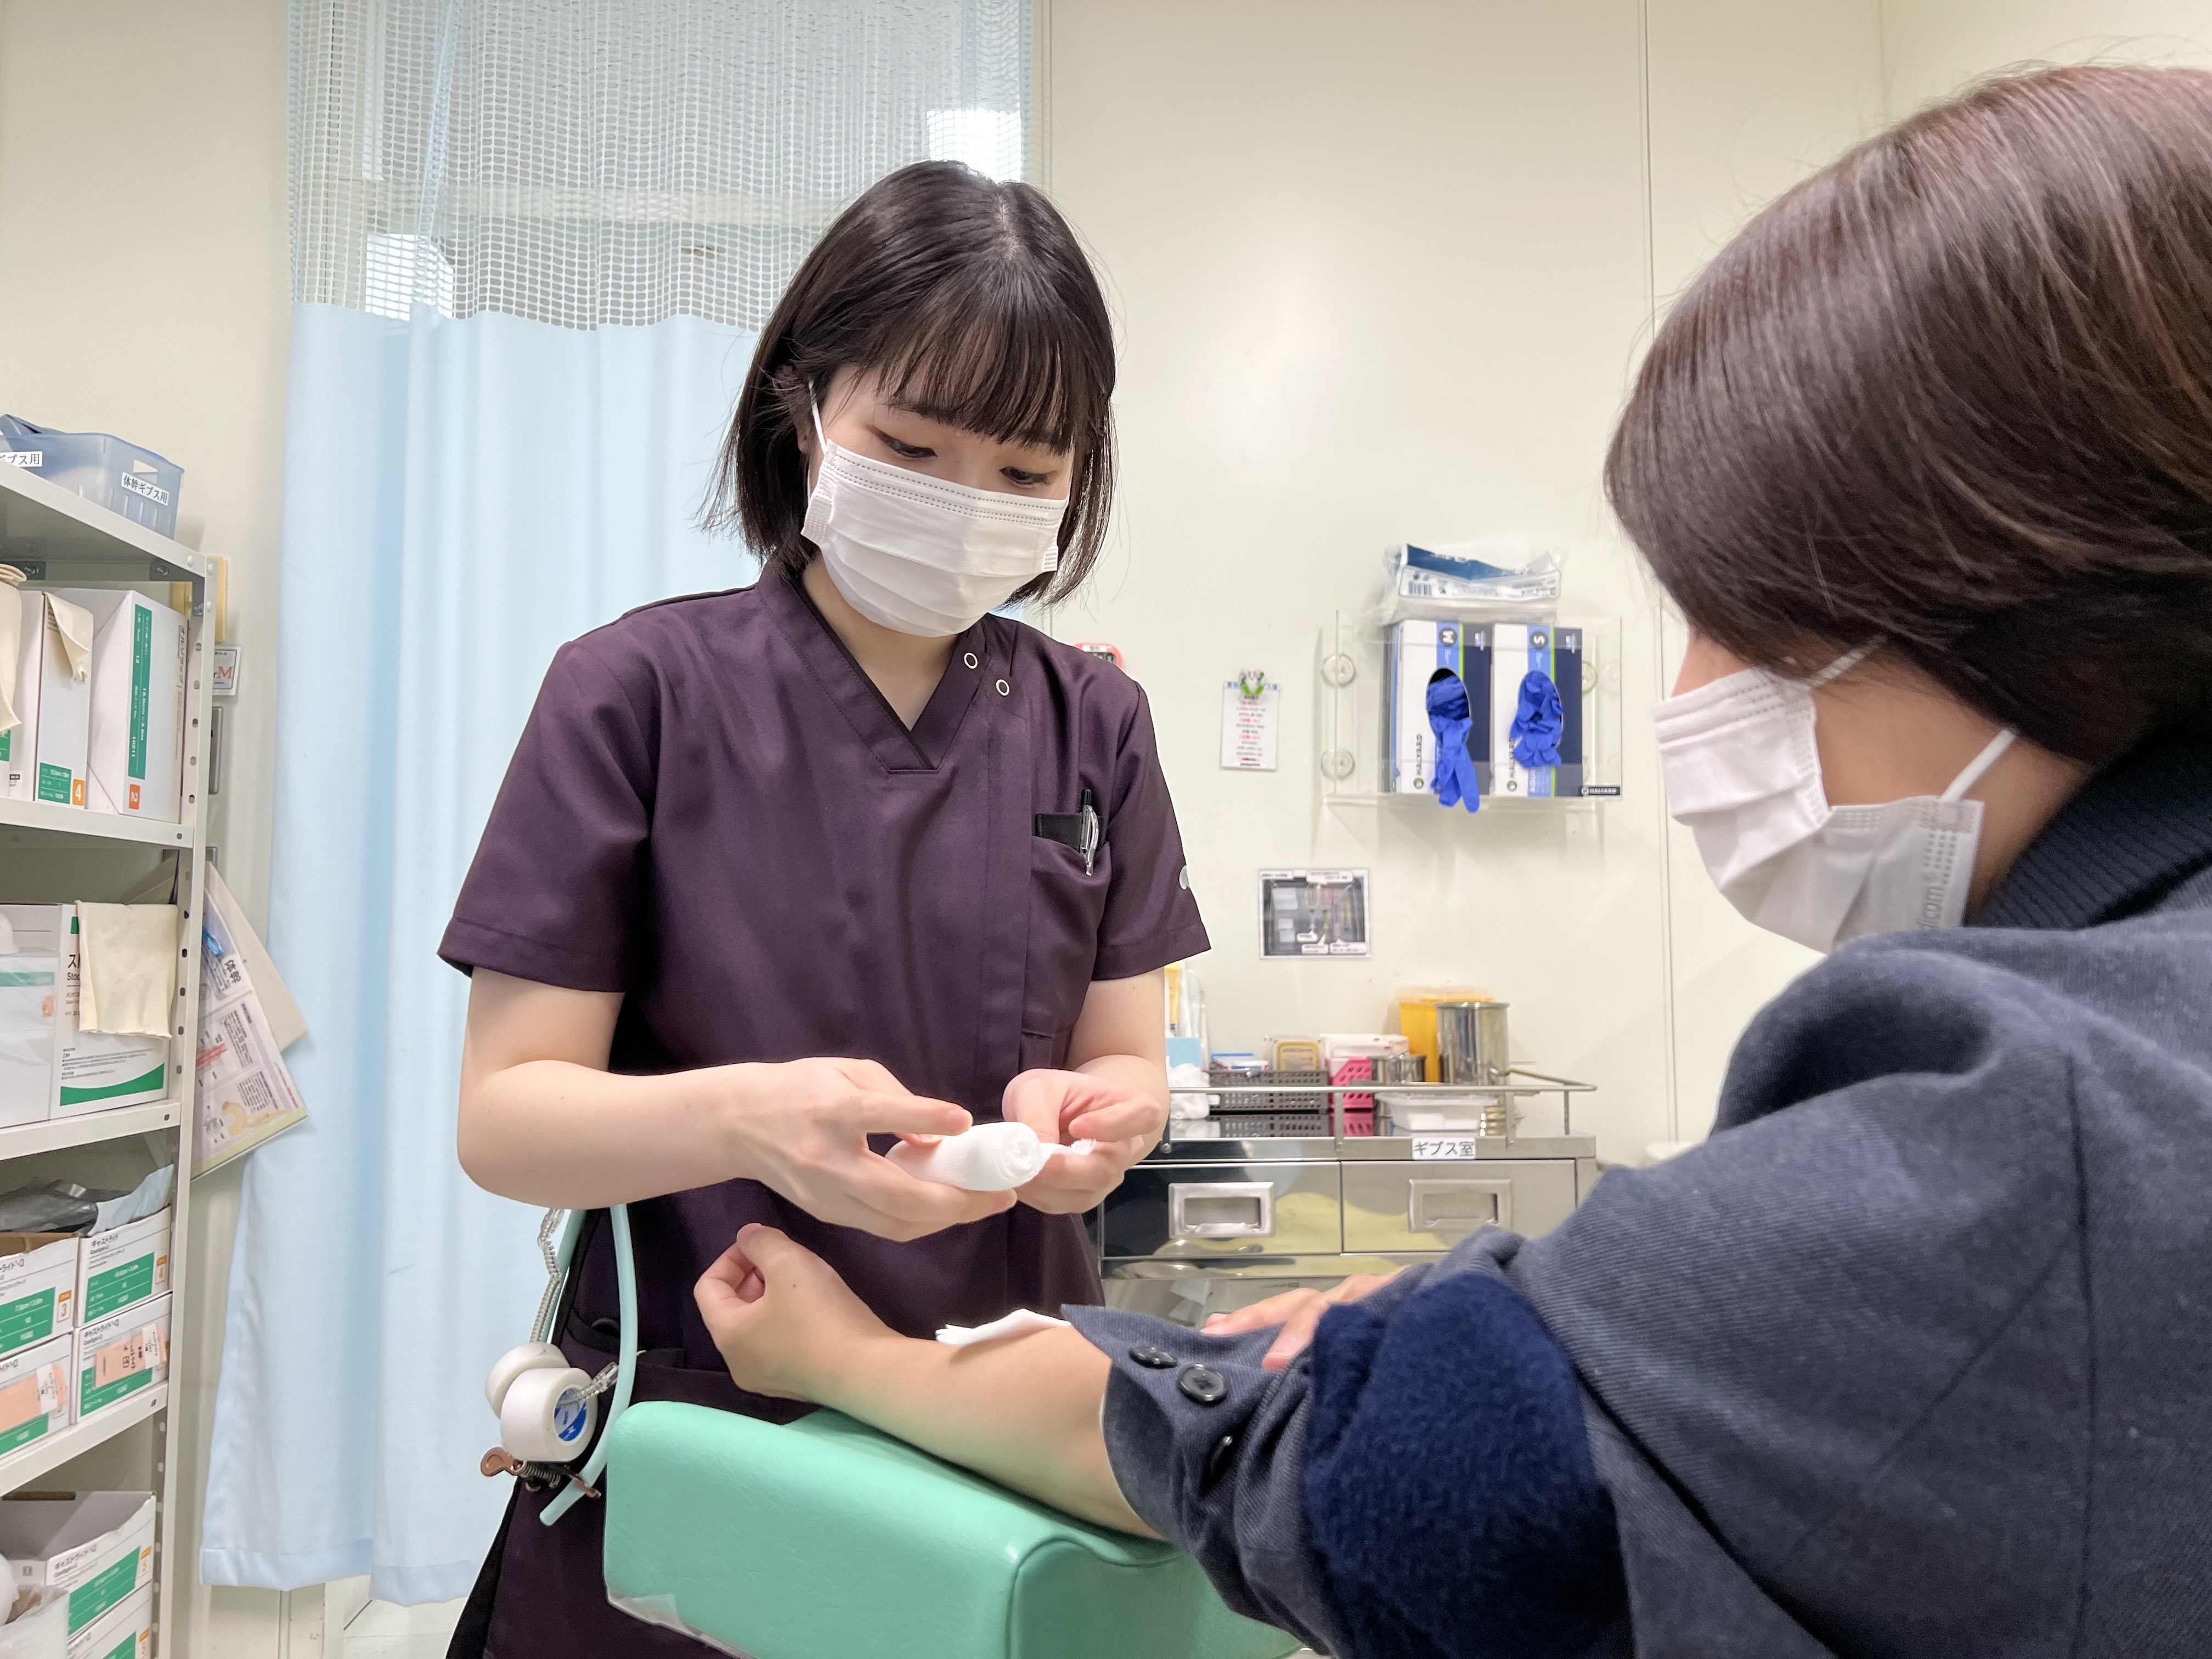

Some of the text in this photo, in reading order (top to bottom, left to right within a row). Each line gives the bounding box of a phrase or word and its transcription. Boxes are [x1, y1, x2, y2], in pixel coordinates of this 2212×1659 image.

[1442, 630, 1454, 644] M
[1533, 635, 1545, 645] S
[75, 784, 82, 801] 4
[131, 791, 138, 803] 2
[61, 1302, 67, 1317] 3
